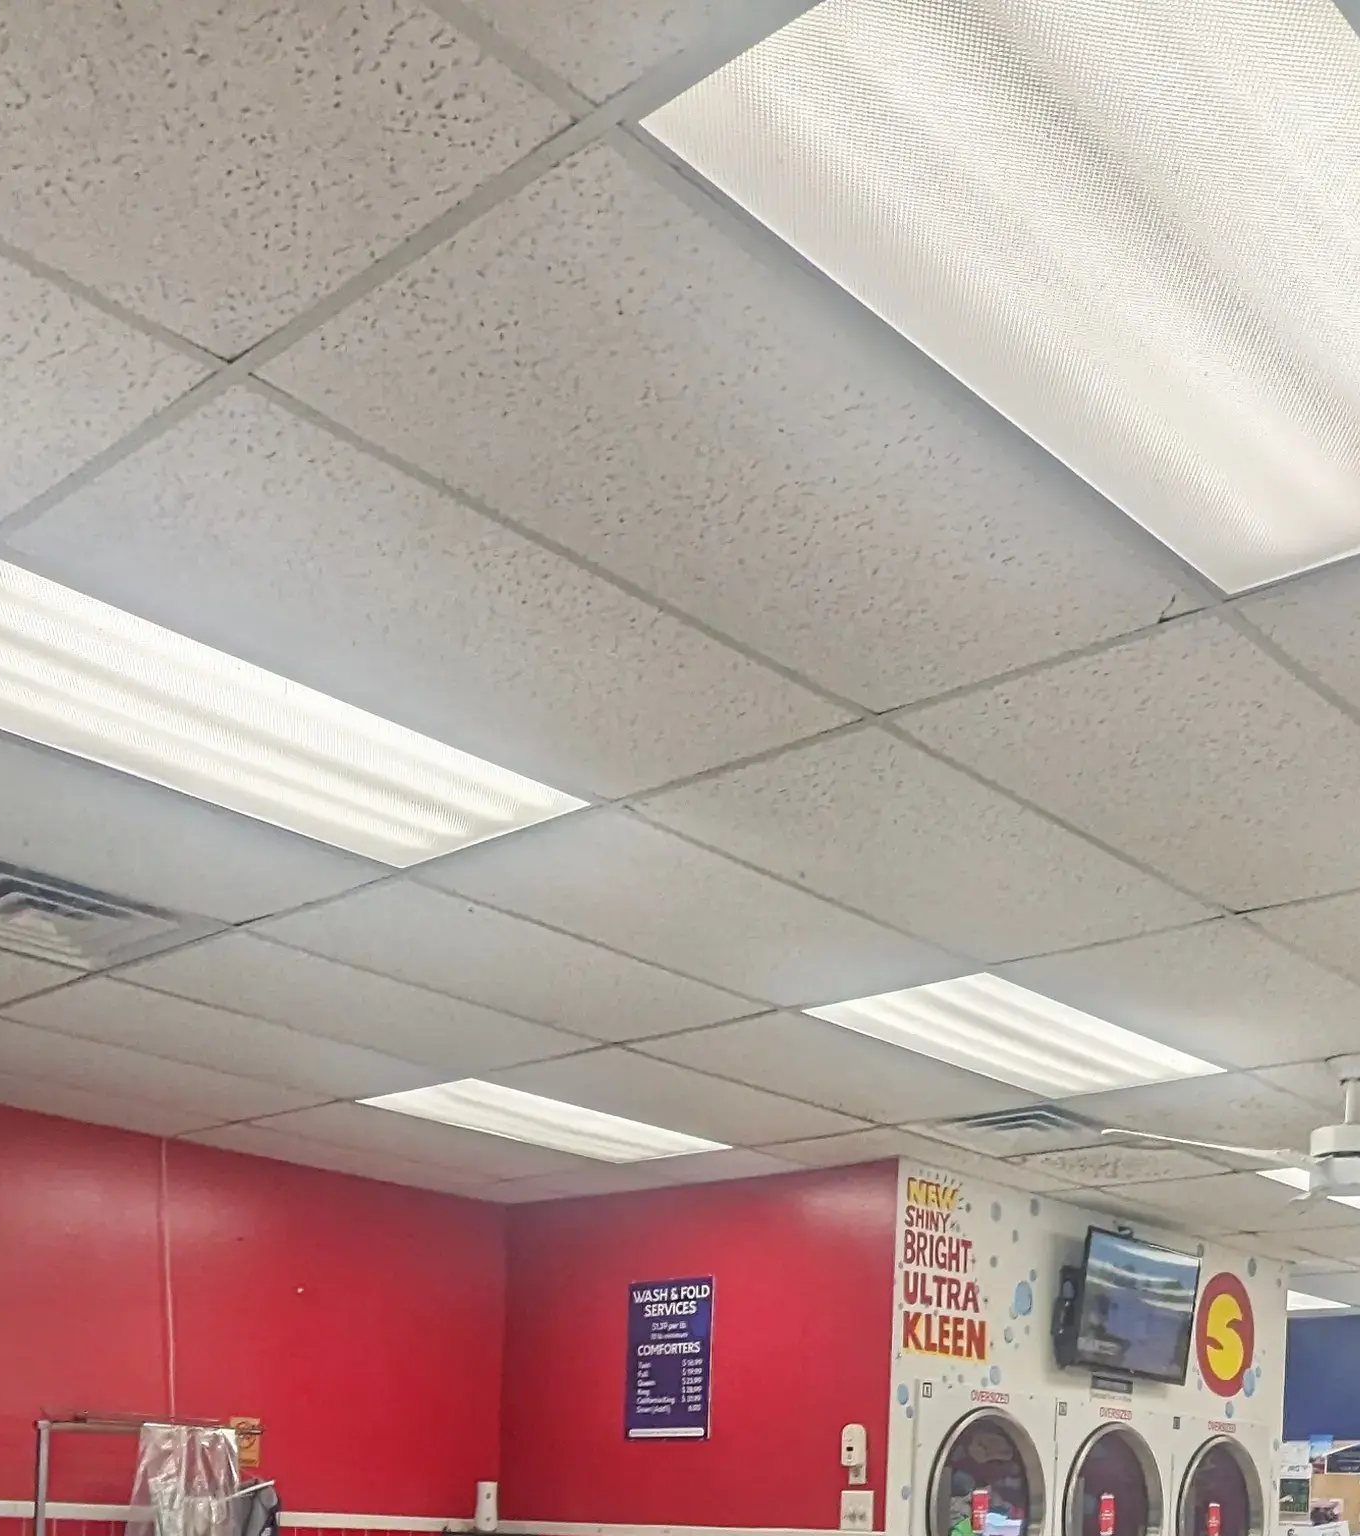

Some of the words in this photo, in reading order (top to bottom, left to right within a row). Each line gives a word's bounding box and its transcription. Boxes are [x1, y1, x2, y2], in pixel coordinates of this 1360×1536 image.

[906, 1177, 959, 1210] NEW
[904, 1205, 951, 1233] SHINY
[903, 1229, 973, 1273] BRIGHT
[633, 1288, 668, 1303] WASH
[670, 1287, 679, 1300] &
[680, 1284, 710, 1299] FOLD
[903, 1271, 980, 1313] ULTRA
[643, 1301, 697, 1318] SERVICES
[637, 1342, 701, 1356] COMFORTERS
[902, 1310, 986, 1360] KLEEN
[1206, 1293, 1244, 1381] S
[971, 1389, 1010, 1404] OVERSIZED
[1099, 1406, 1133, 1421] OVERSIZED
